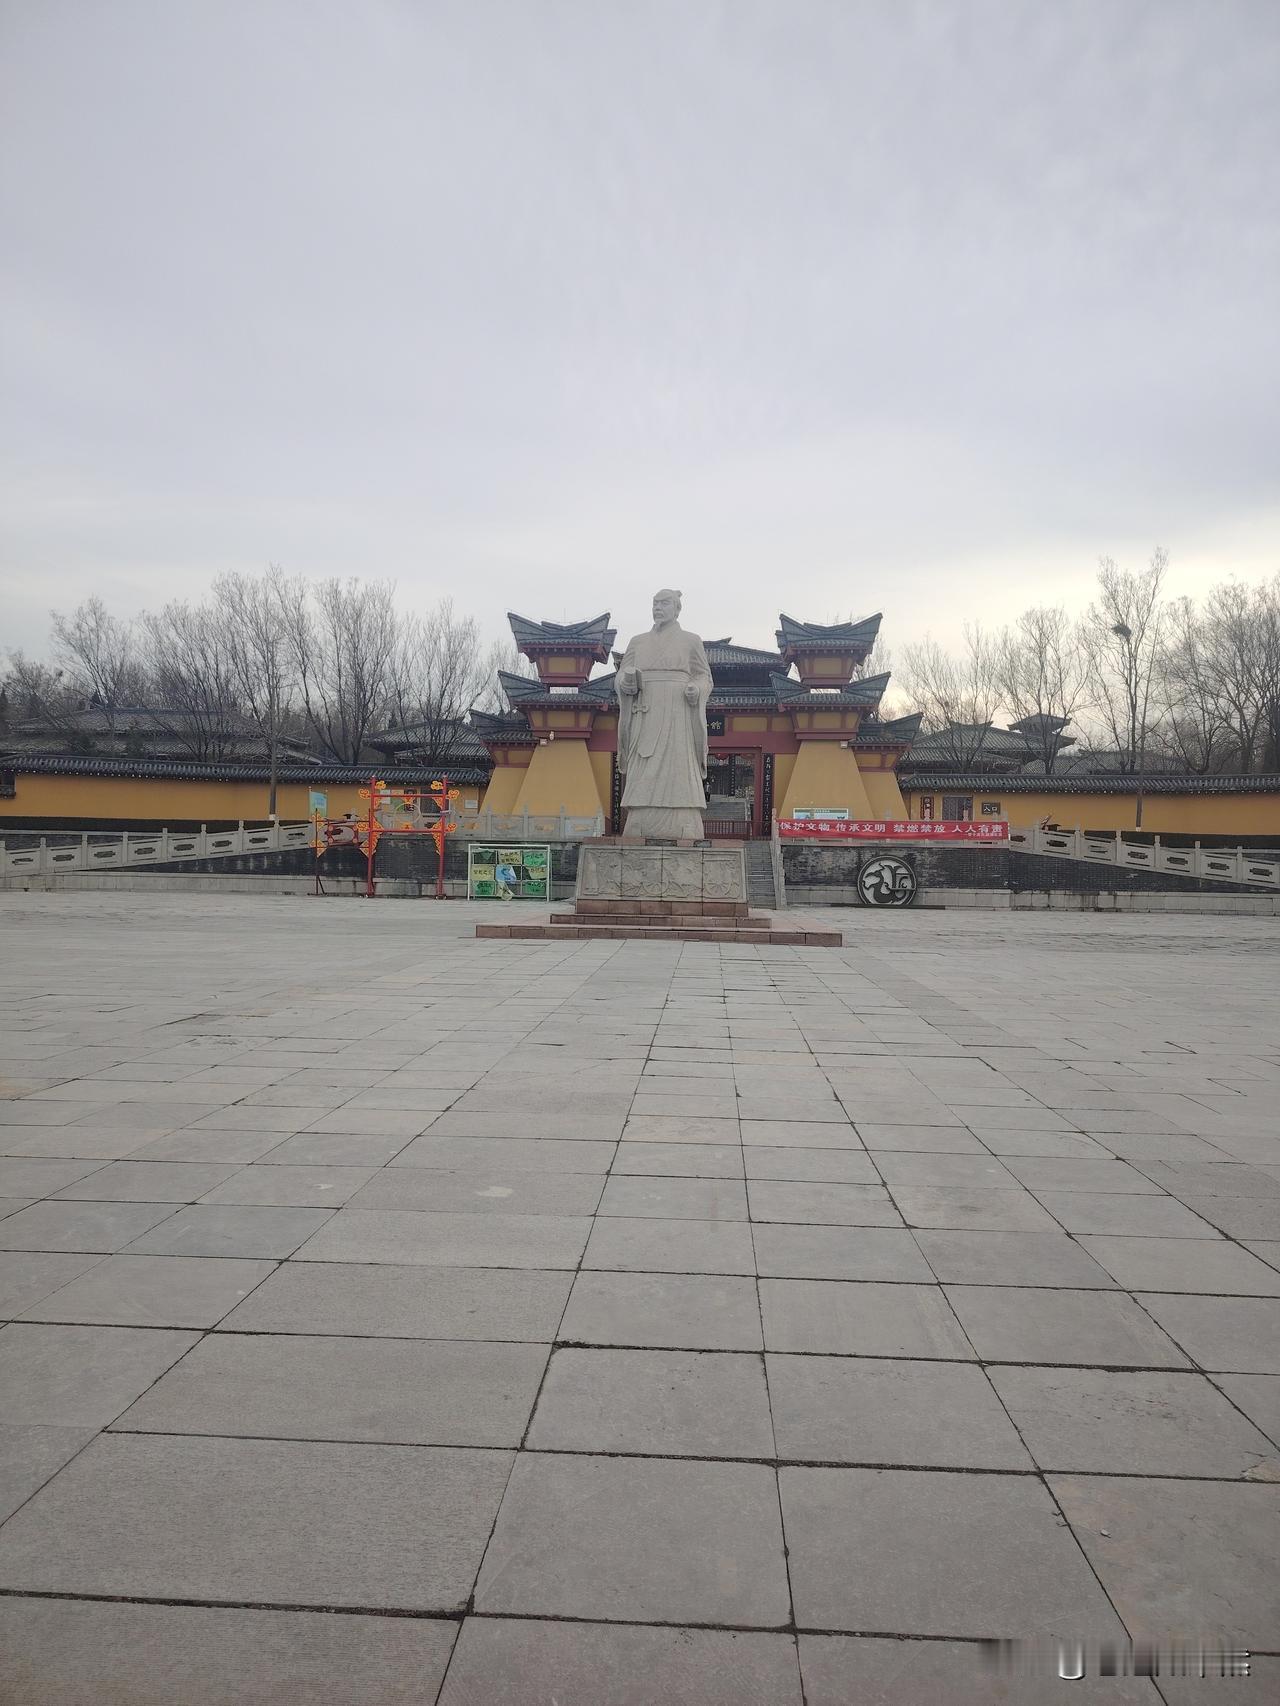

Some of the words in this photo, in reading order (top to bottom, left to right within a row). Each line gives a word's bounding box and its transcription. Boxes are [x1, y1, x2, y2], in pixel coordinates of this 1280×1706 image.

[780, 821, 830, 831] 保护文物
[835, 823, 886, 832] 传承文明
[893, 823, 945, 833] 禁燃禁放
[952, 824, 1003, 833] 人人有责
